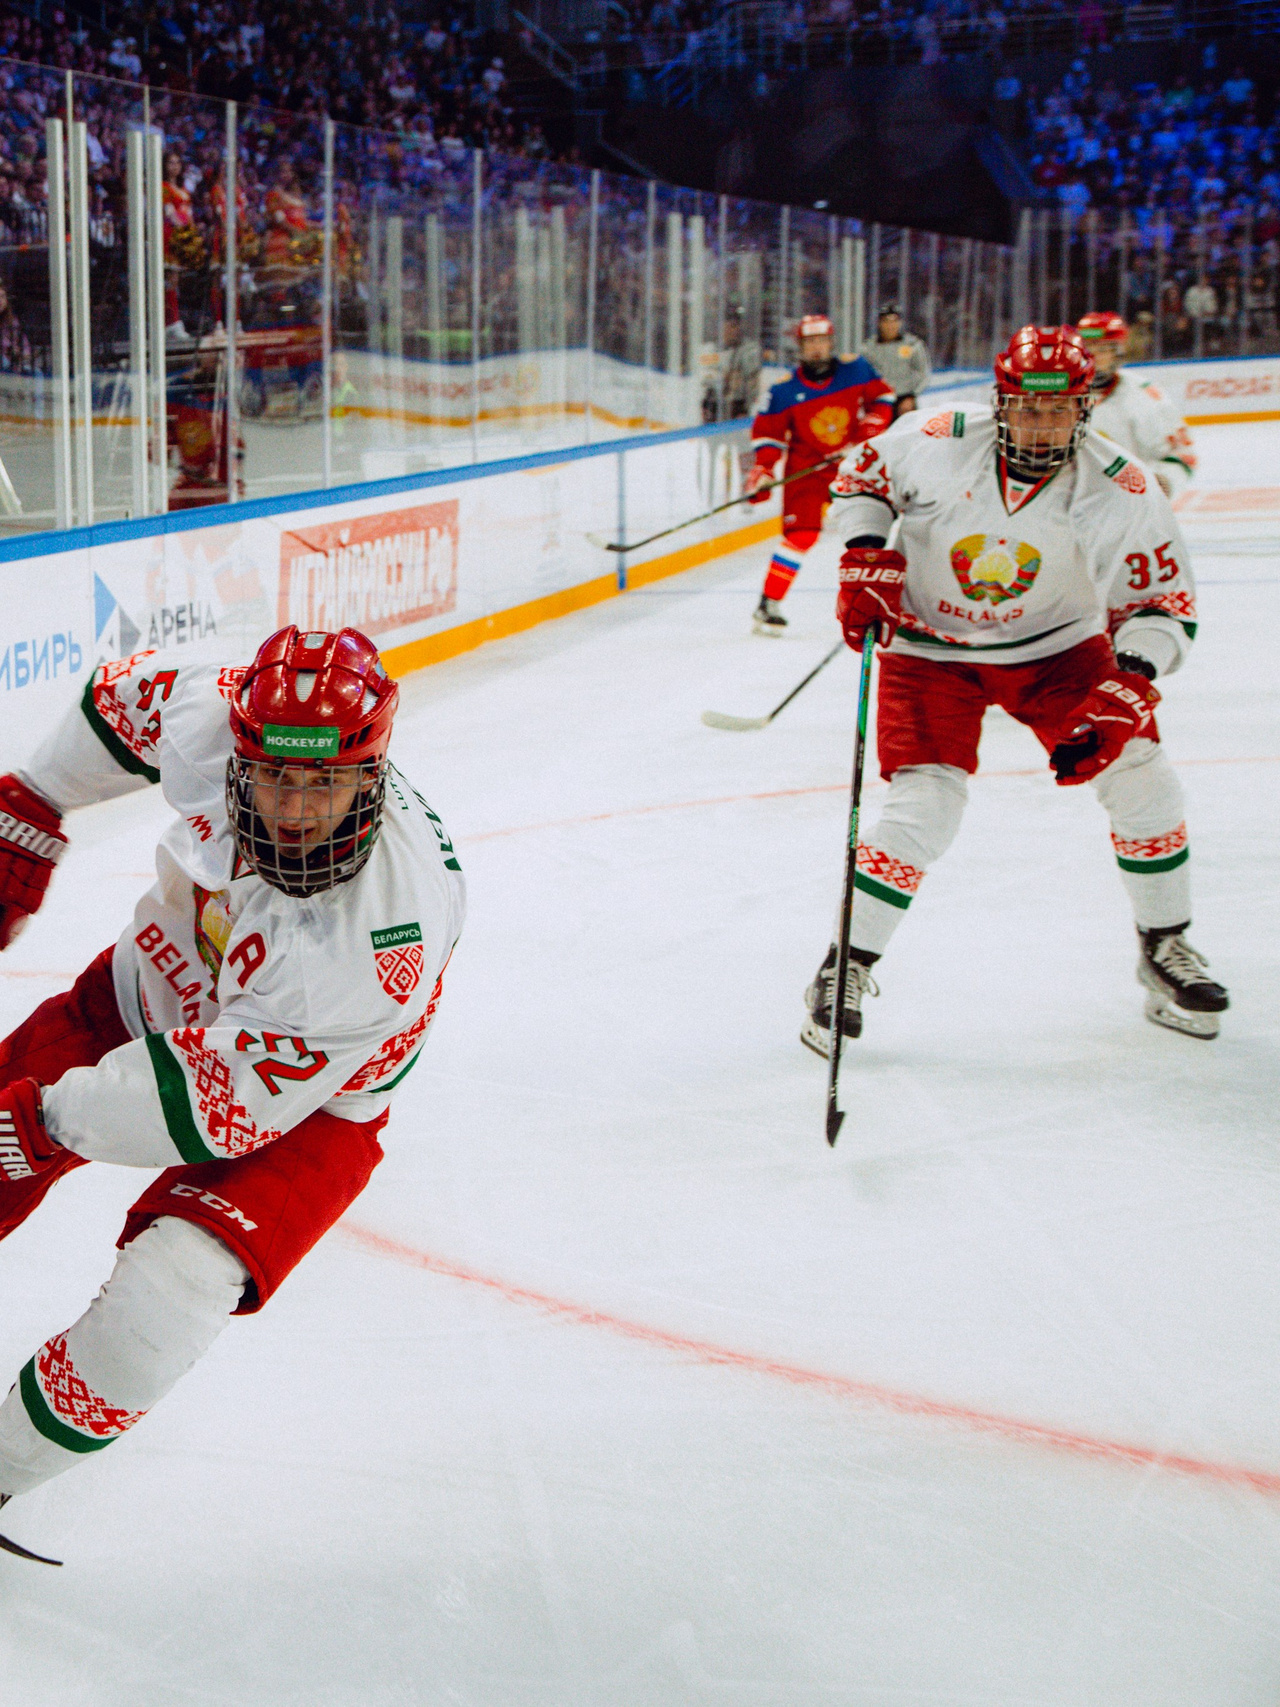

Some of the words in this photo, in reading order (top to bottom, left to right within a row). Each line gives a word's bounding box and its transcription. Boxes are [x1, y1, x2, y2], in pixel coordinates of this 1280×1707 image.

[1124, 541, 1179, 590] 35
[148, 602, 218, 650] АРЕНА
[266, 735, 334, 748] HOCKEY.BY
[227, 932, 267, 989] A
[373, 928, 421, 945] БЕЛАРУСЬ
[169, 1182, 259, 1232] CCM
